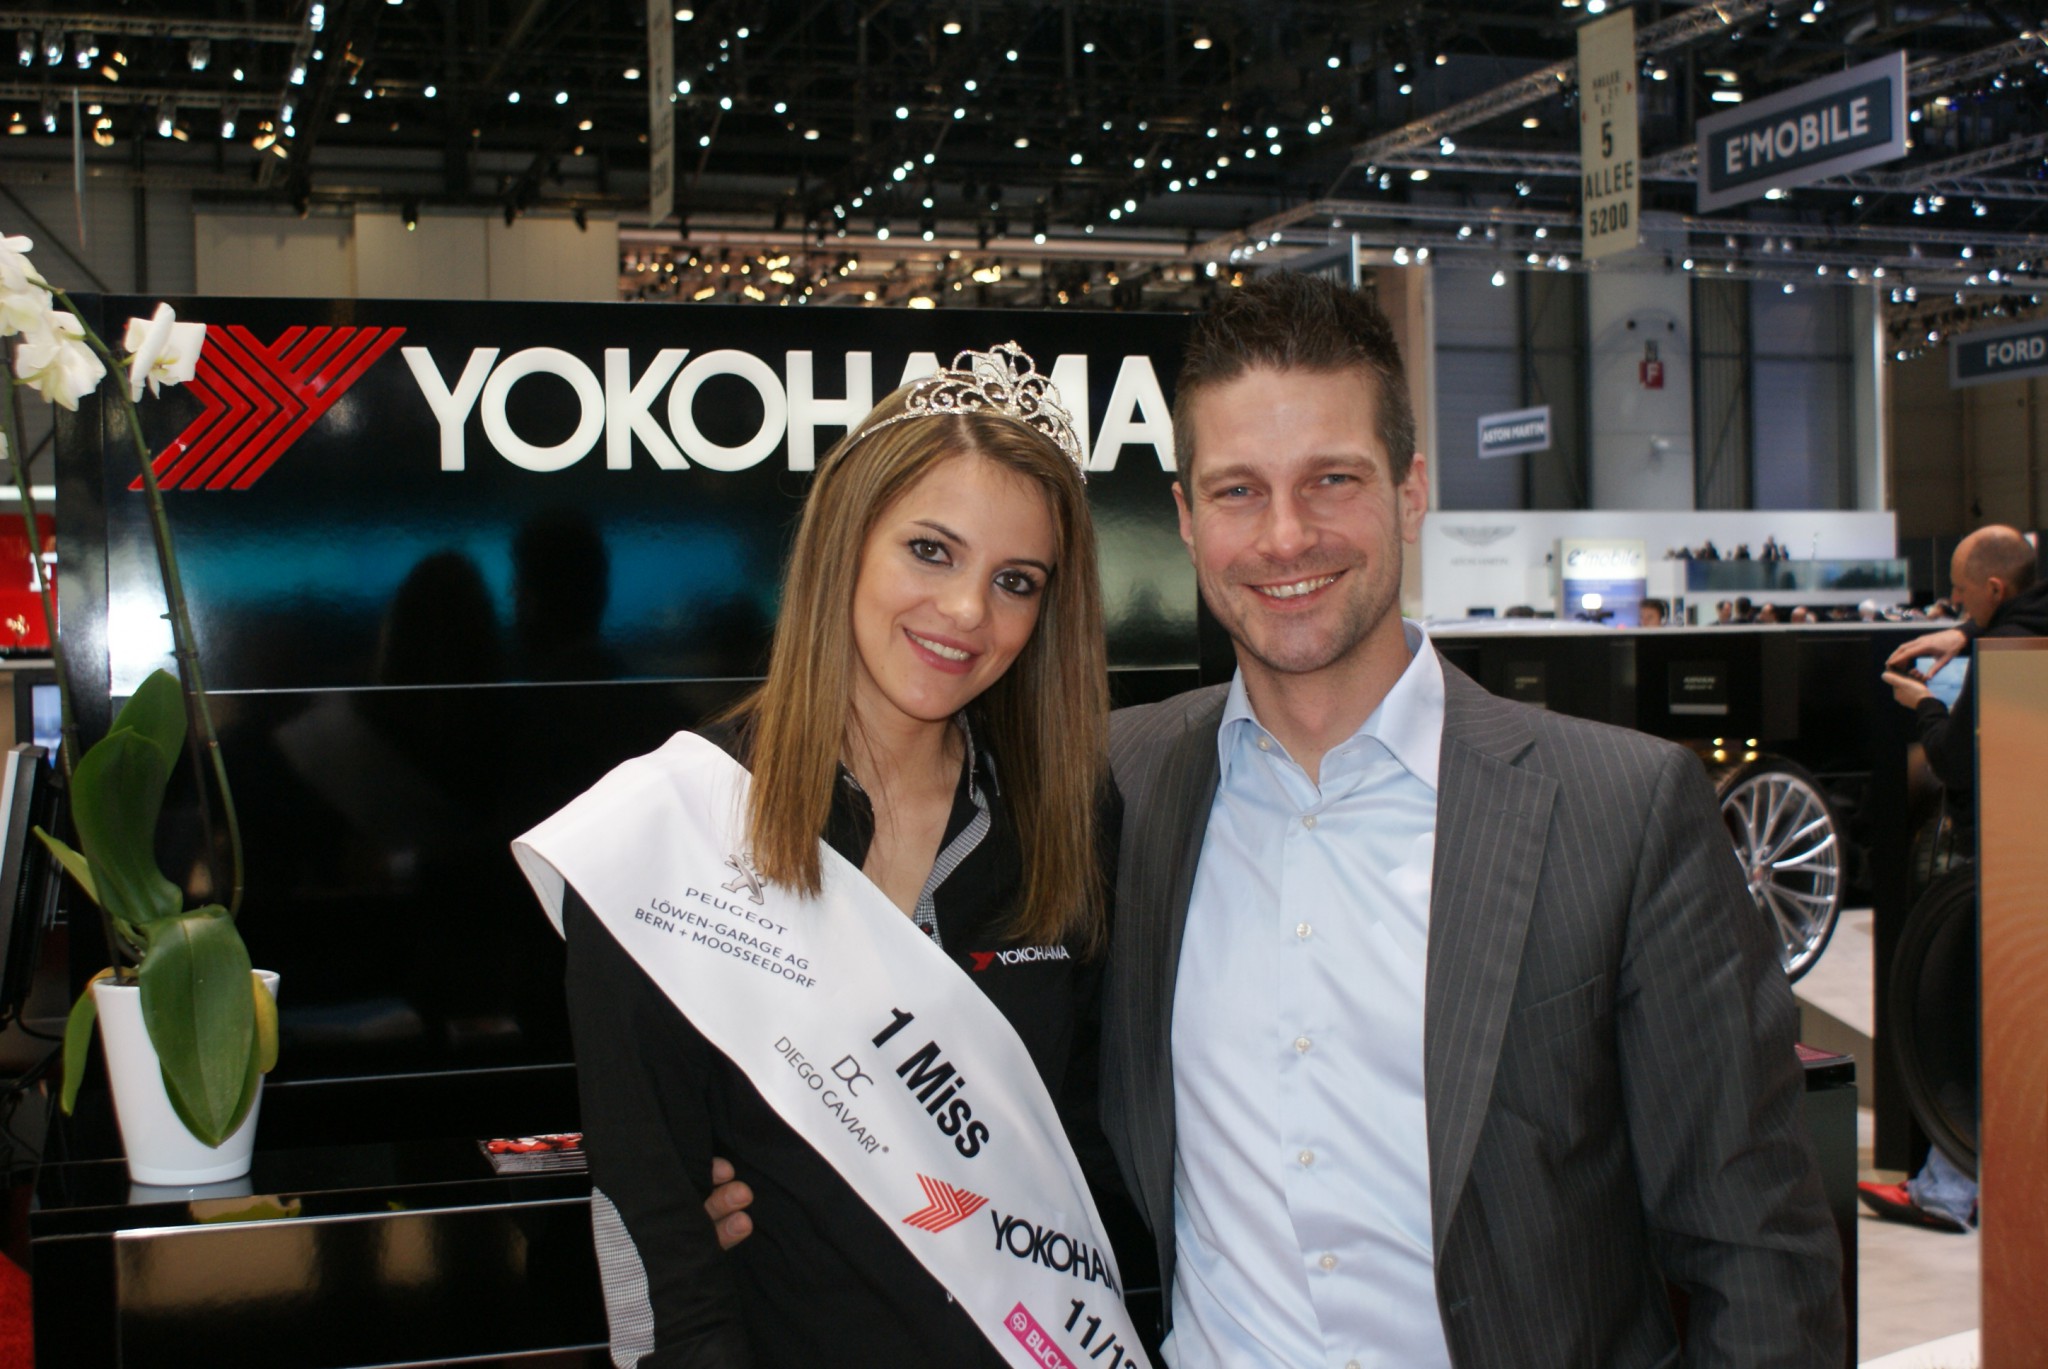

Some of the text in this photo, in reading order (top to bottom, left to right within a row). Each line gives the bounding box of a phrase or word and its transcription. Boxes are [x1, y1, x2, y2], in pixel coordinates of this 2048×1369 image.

[1601, 121, 1613, 158] 5
[1726, 96, 1869, 175] E'MOBILE
[1584, 160, 1633, 201] ALLEE
[1589, 202, 1628, 237] 5200
[1986, 336, 2046, 367] FORD
[401, 346, 1178, 473] YOKOHA
[1483, 421, 1545, 443] ASTON MARTIN
[651, 897, 809, 970] LÖWEN-GARAGE AG
[685, 887, 788, 935] PEUGEOT
[634, 908, 675, 933] BERN
[692, 931, 816, 988] MOOSSEEDORF
[996, 945, 1070, 966] YOKOHAMA
[774, 1036, 823, 1090] DIEGO
[872, 1007, 990, 1158] 1 Miss
